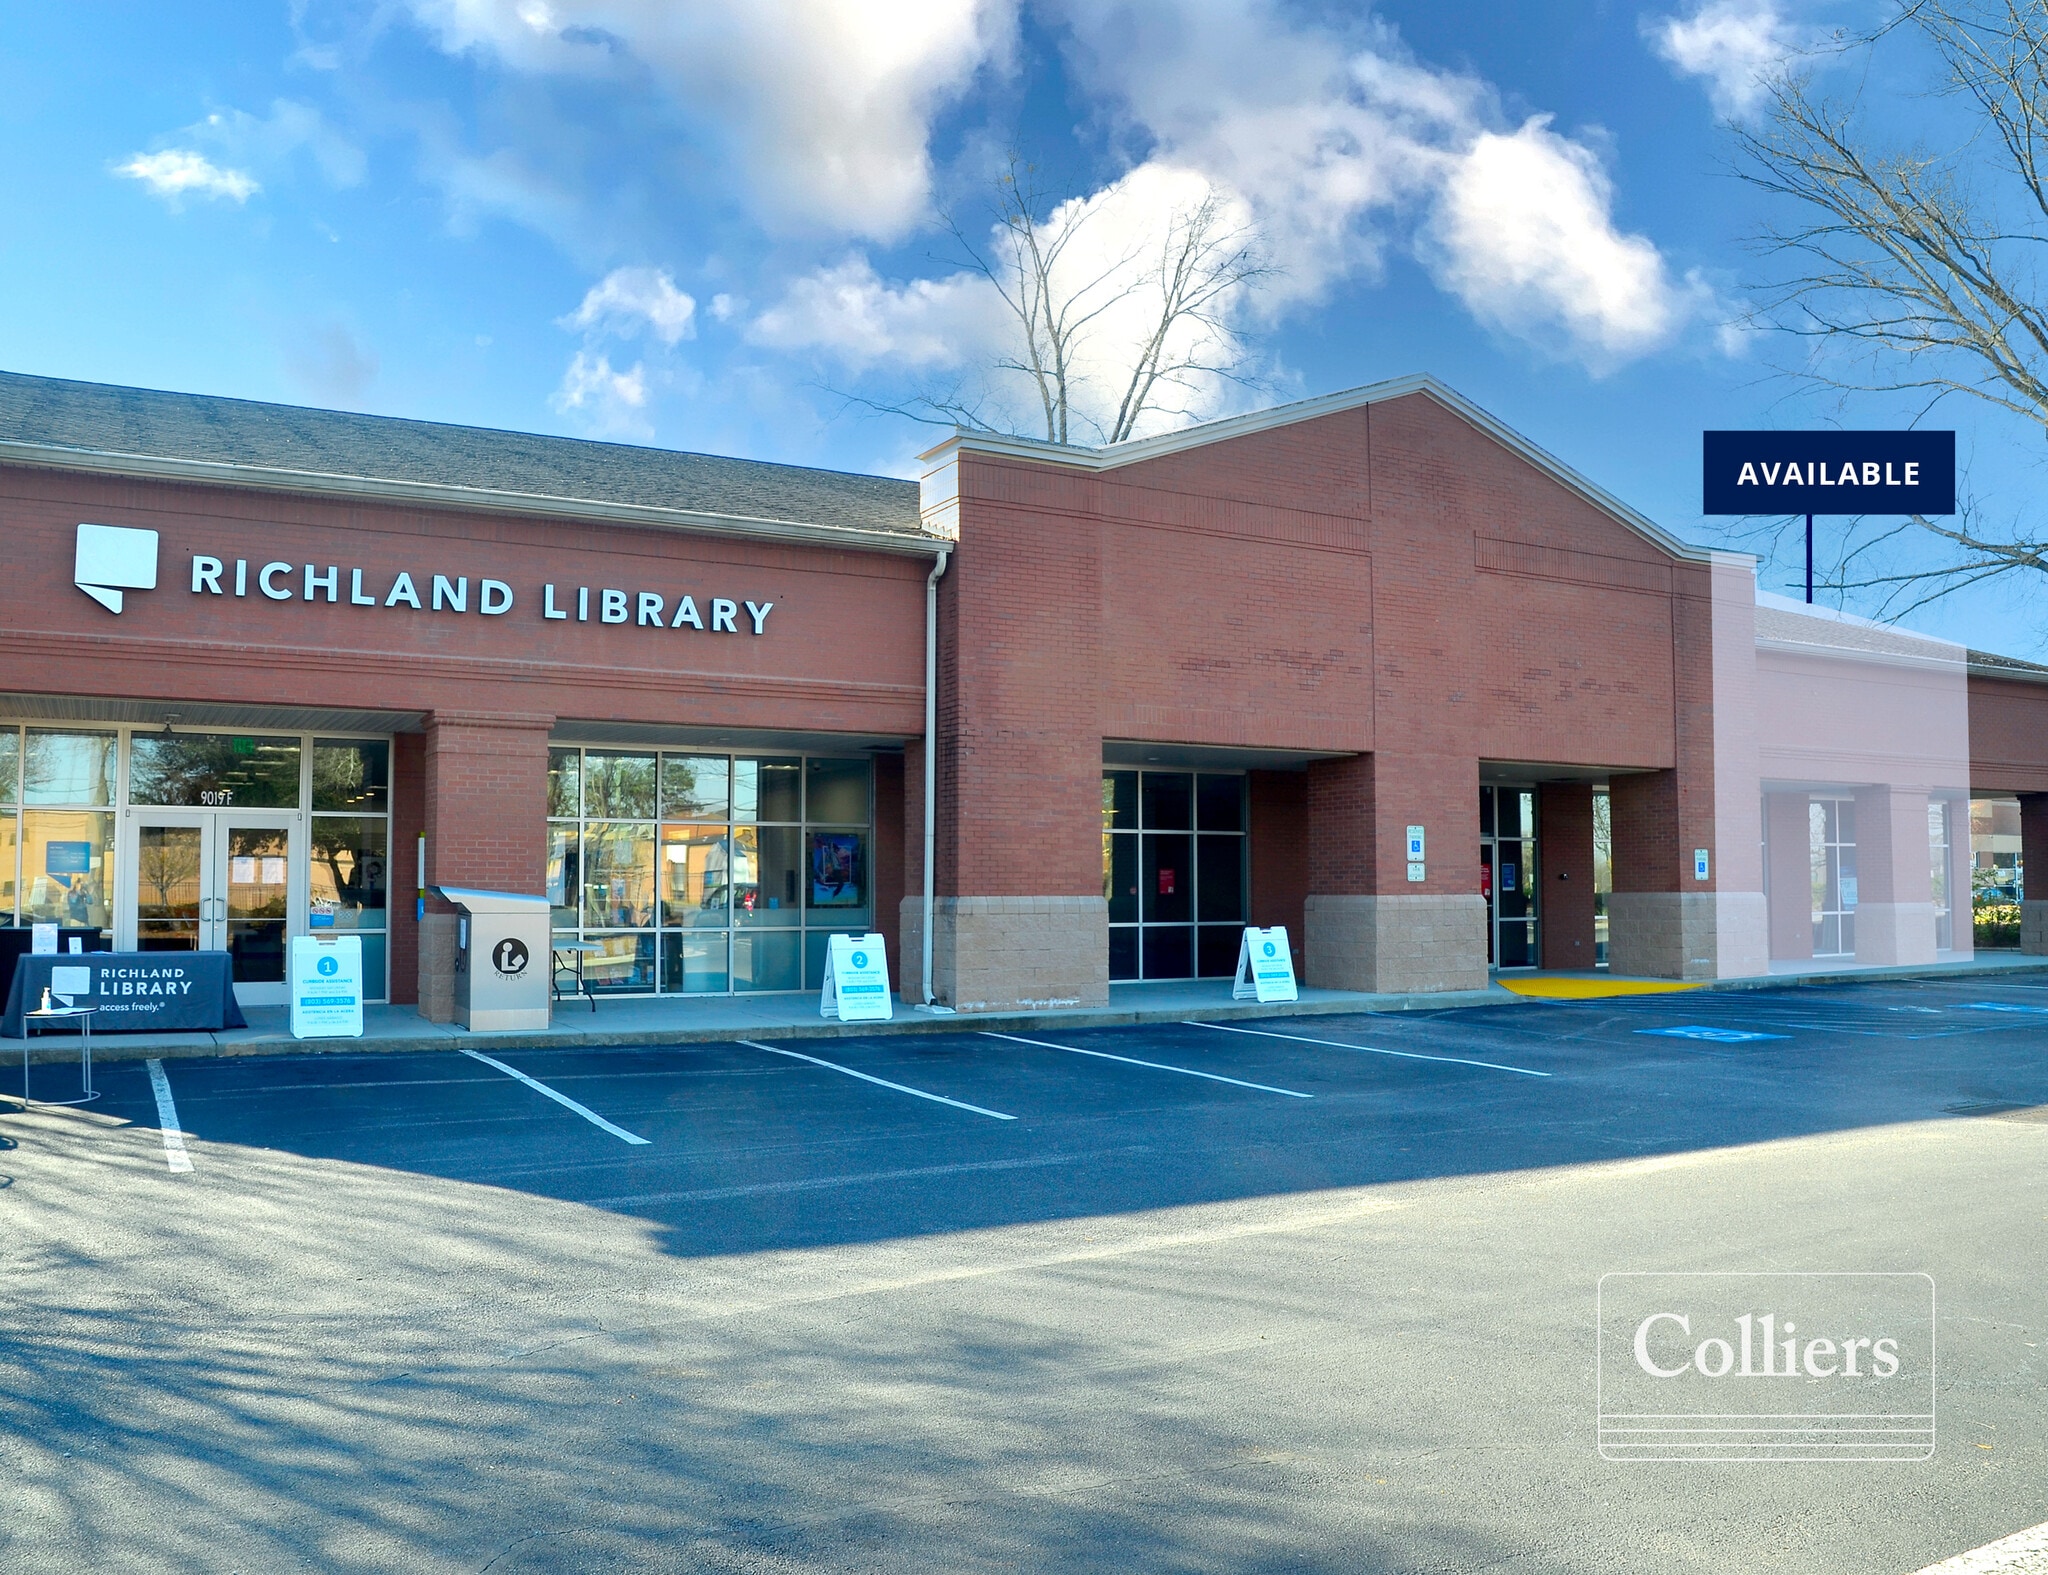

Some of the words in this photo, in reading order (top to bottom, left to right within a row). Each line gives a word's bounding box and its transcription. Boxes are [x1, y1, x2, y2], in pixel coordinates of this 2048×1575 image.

[190, 554, 515, 616] RICHLAND
[543, 582, 775, 636] LIBRARY
[200, 790, 225, 806] 9019
[226, 791, 233, 806] F
[1266, 945, 1273, 954] 3
[856, 955, 864, 965] 2
[323, 961, 332, 973] 1
[100, 968, 185, 979] RICHLAND
[494, 970, 528, 981] RETURN
[99, 981, 193, 996] LIBRARY
[99, 1003, 130, 1012] access
